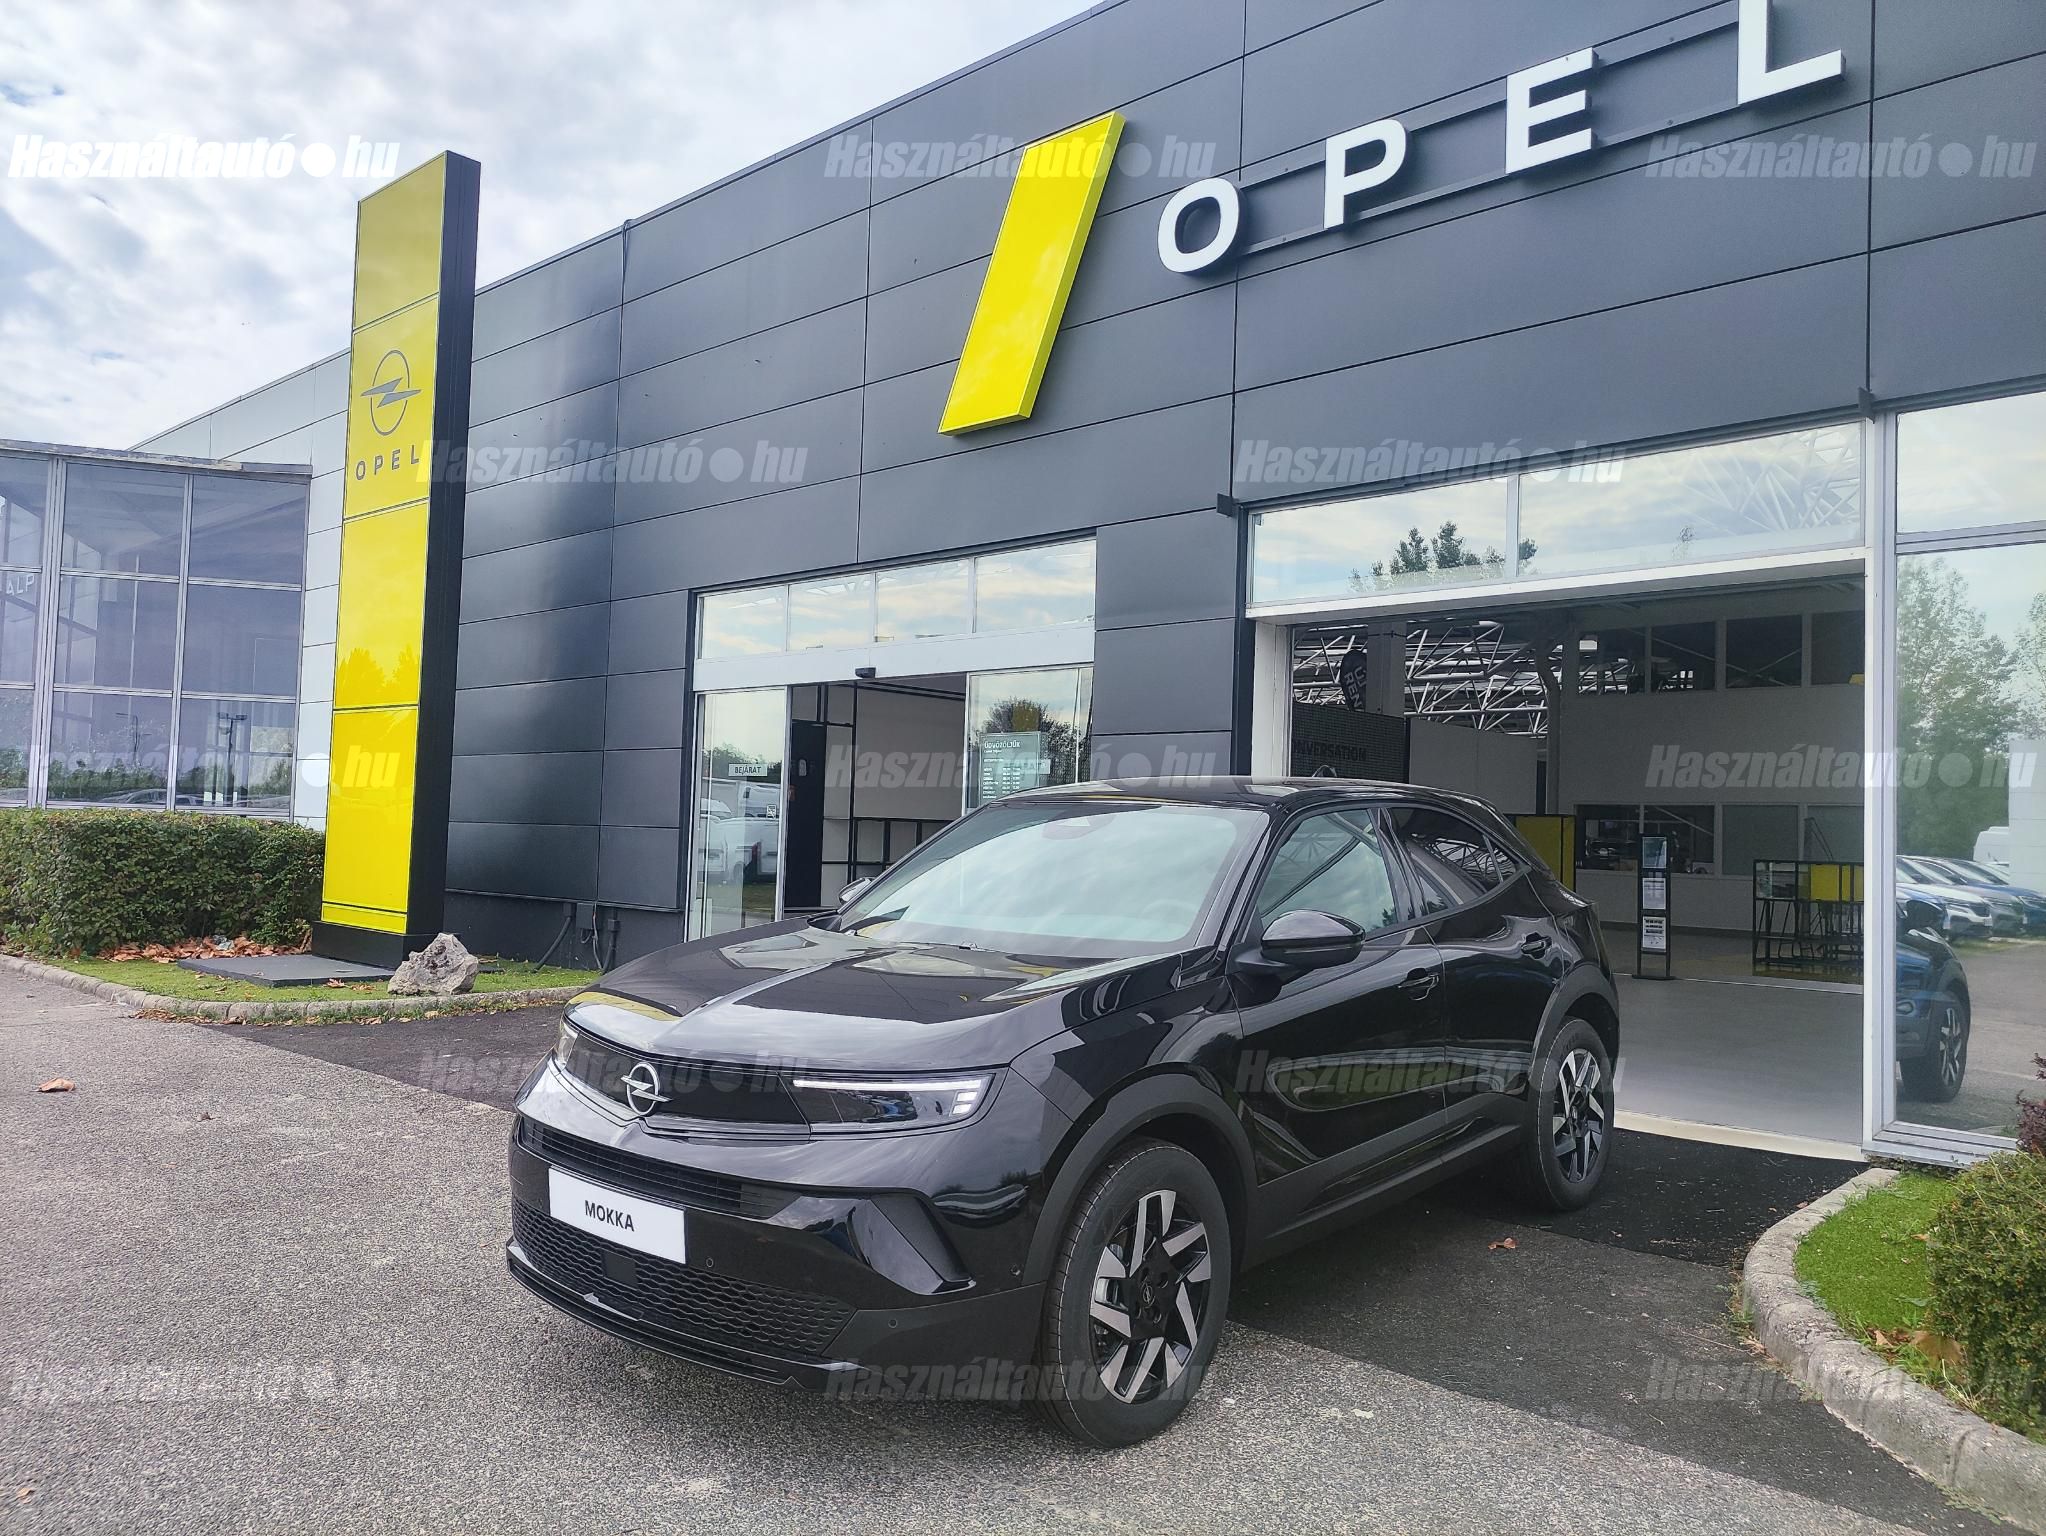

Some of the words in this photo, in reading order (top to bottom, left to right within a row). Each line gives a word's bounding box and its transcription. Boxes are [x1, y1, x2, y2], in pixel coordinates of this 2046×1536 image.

[1158, 0, 1845, 273] OPEL
[356, 445, 419, 480] OPEL
[734, 765, 762, 775] BEJÁRAT
[585, 1200, 635, 1232] MOKKA
